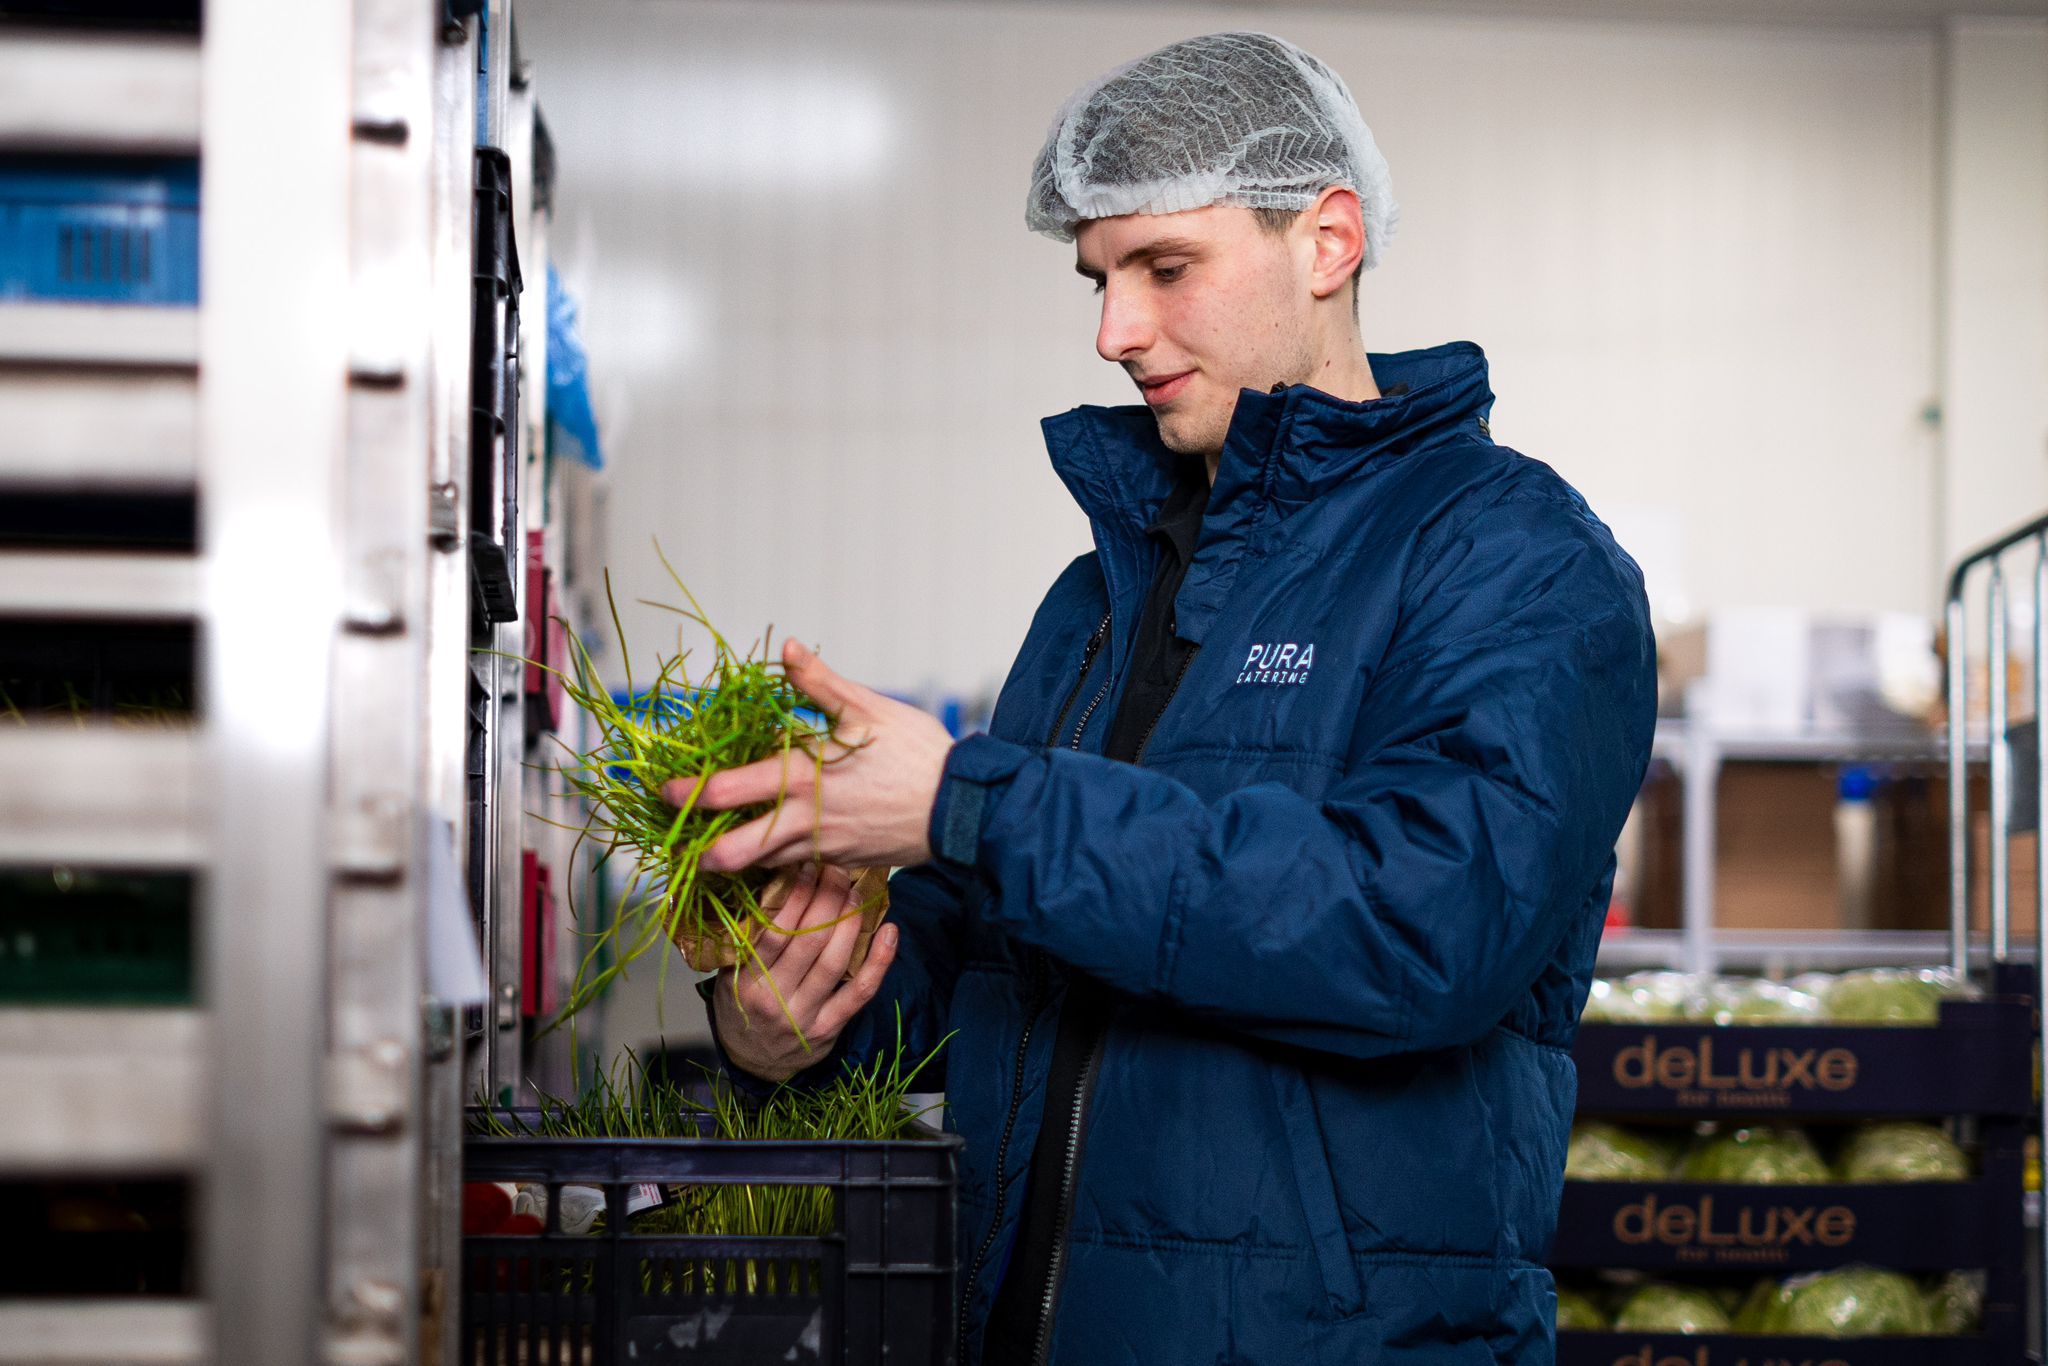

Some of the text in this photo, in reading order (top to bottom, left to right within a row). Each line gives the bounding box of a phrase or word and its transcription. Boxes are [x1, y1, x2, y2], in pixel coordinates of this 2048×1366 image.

[1243, 643, 1314, 670] PURA
[1236, 670, 1308, 684] CATERING
[1613, 1035, 1858, 1090] deLuxe
[1613, 1194, 1857, 1246] deLuxe
